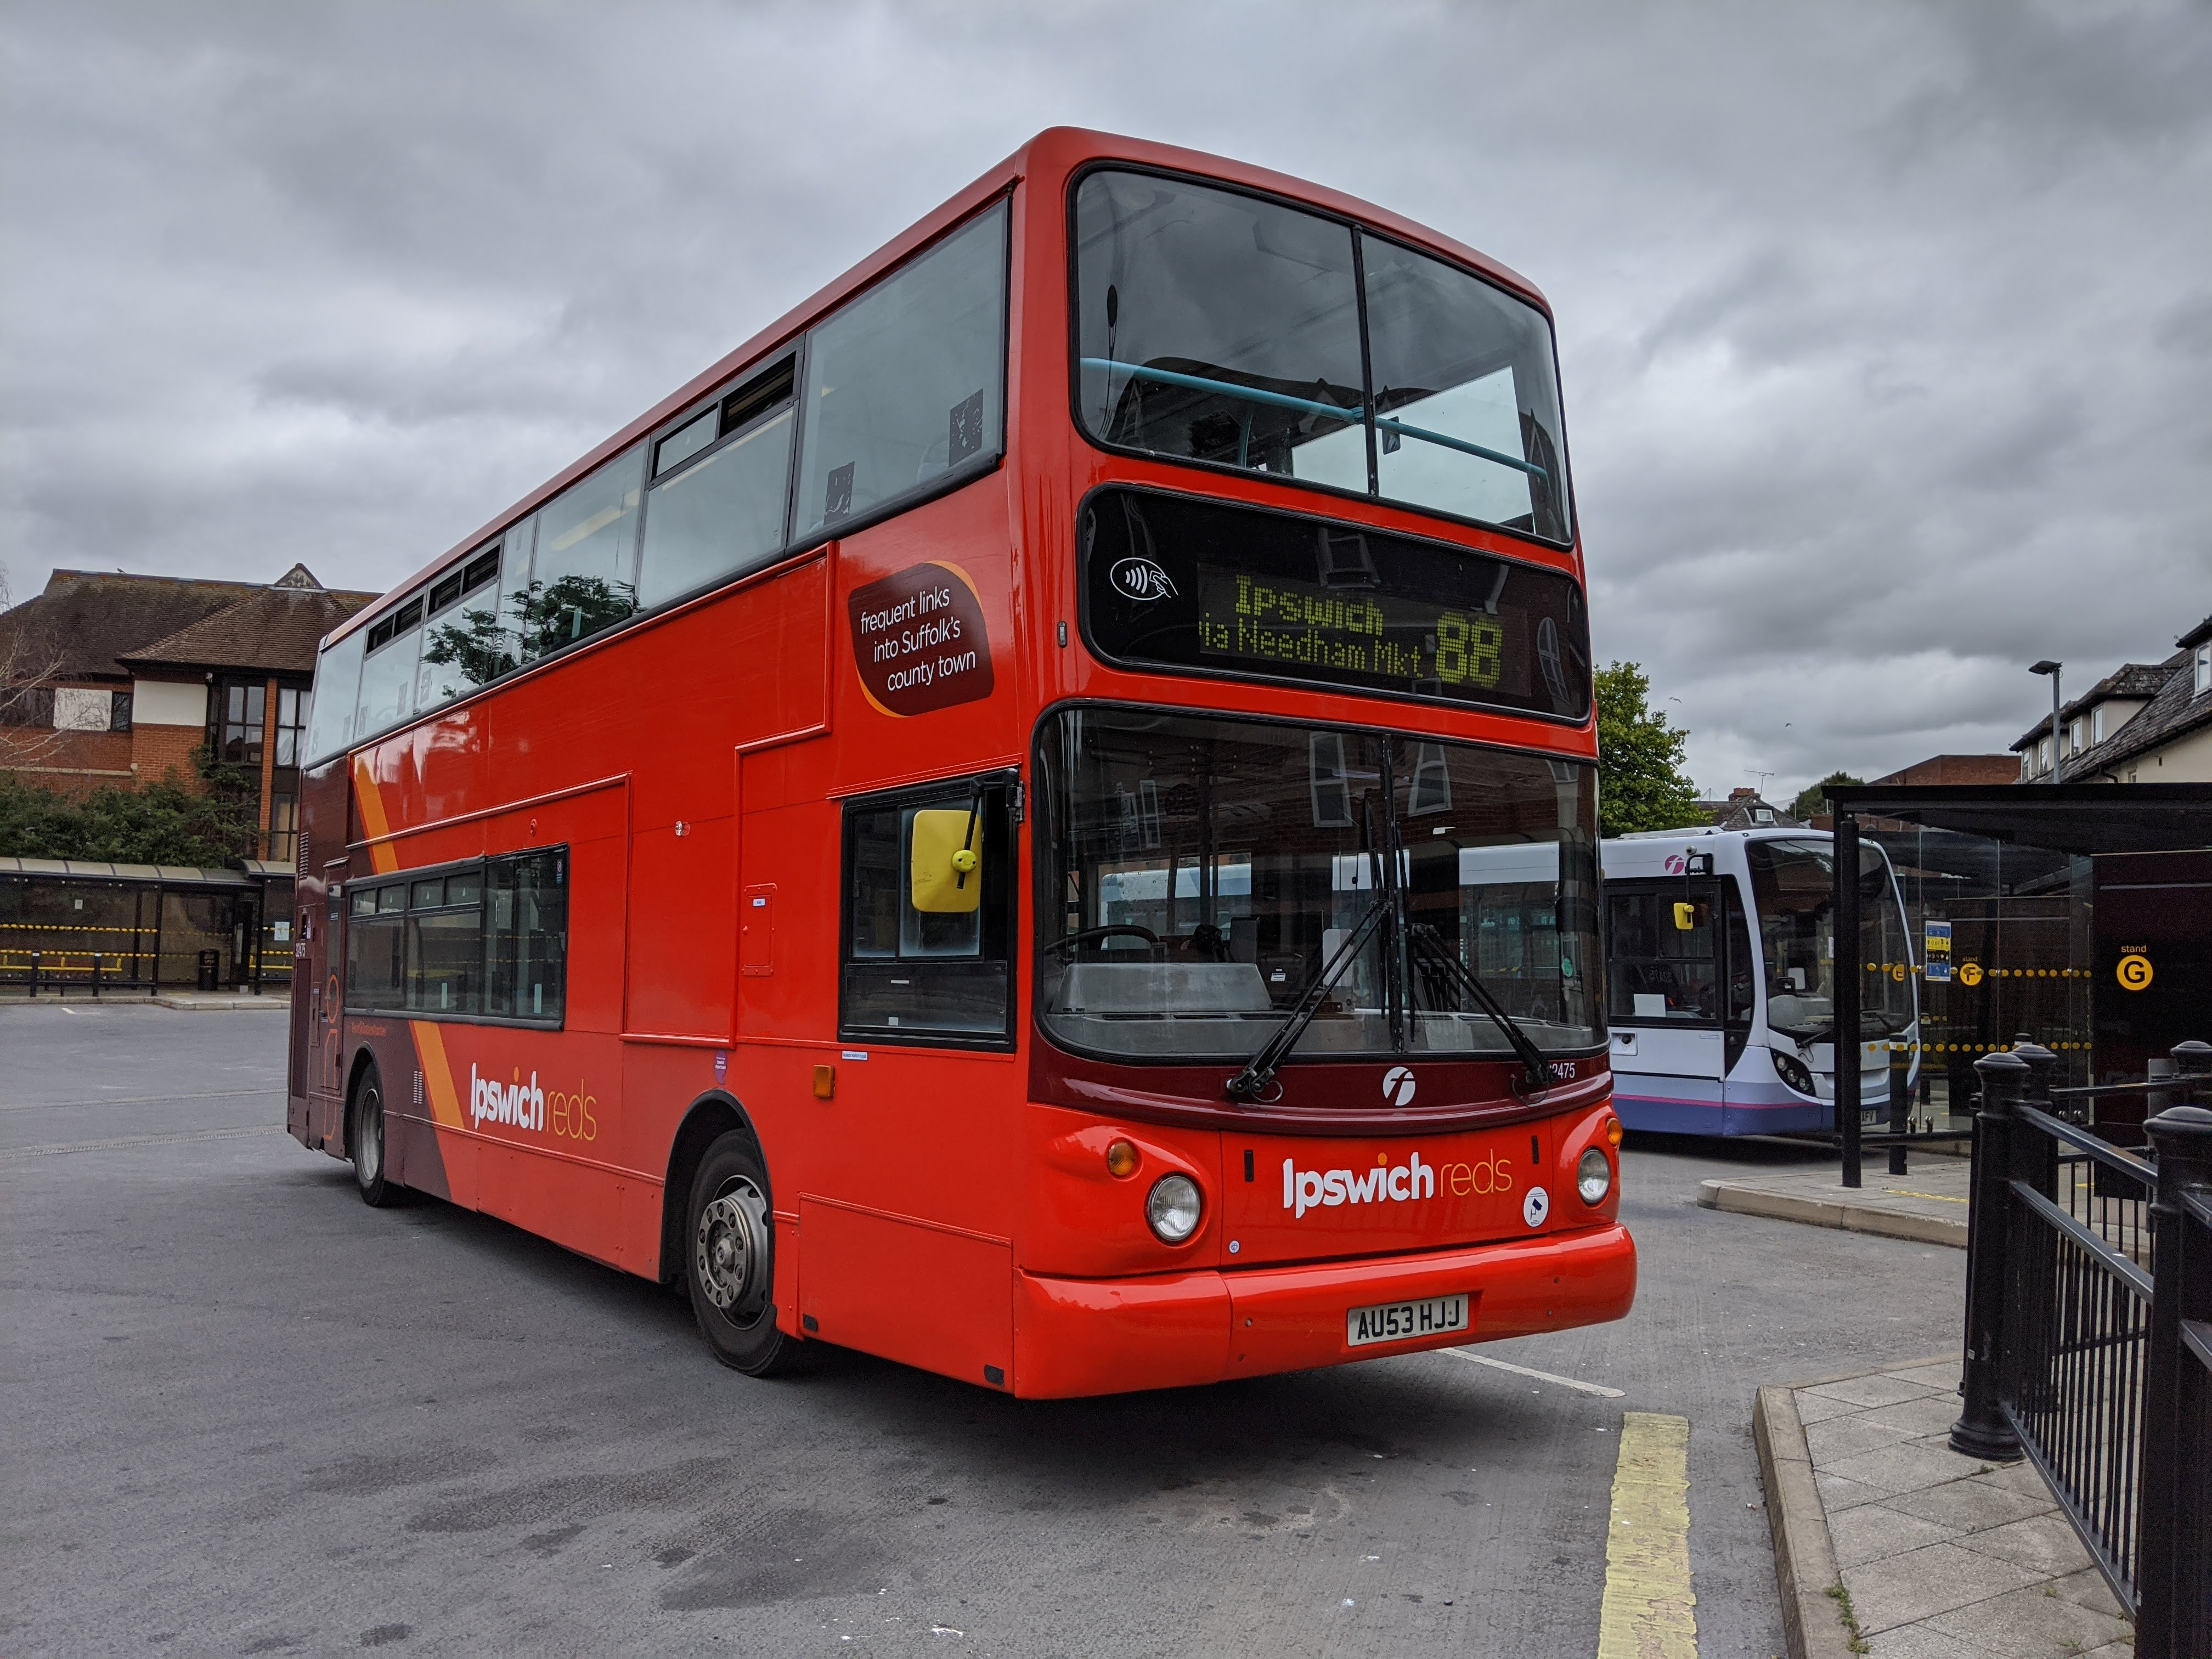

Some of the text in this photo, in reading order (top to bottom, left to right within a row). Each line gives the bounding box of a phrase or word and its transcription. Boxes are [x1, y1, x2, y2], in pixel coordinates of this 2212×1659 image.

[860, 585, 950, 635] frequent links
[1235, 574, 1383, 636] Ipswich
[873, 616, 961, 663] into Suffolk's
[1238, 617, 1365, 670] Needham
[1374, 639, 1424, 678] Mkt
[1436, 611, 1503, 689] 88
[887, 651, 976, 691] county town
[2121, 944, 2147, 953] stand
[2124, 961, 2146, 983] G
[1966, 967, 1976, 981] F
[1549, 1062, 1576, 1079] 2475
[471, 1062, 597, 1141] Ipswich reds
[1283, 1148, 1512, 1219] Ipswich reds
[1357, 1299, 1460, 1340] AU53 HJJ
